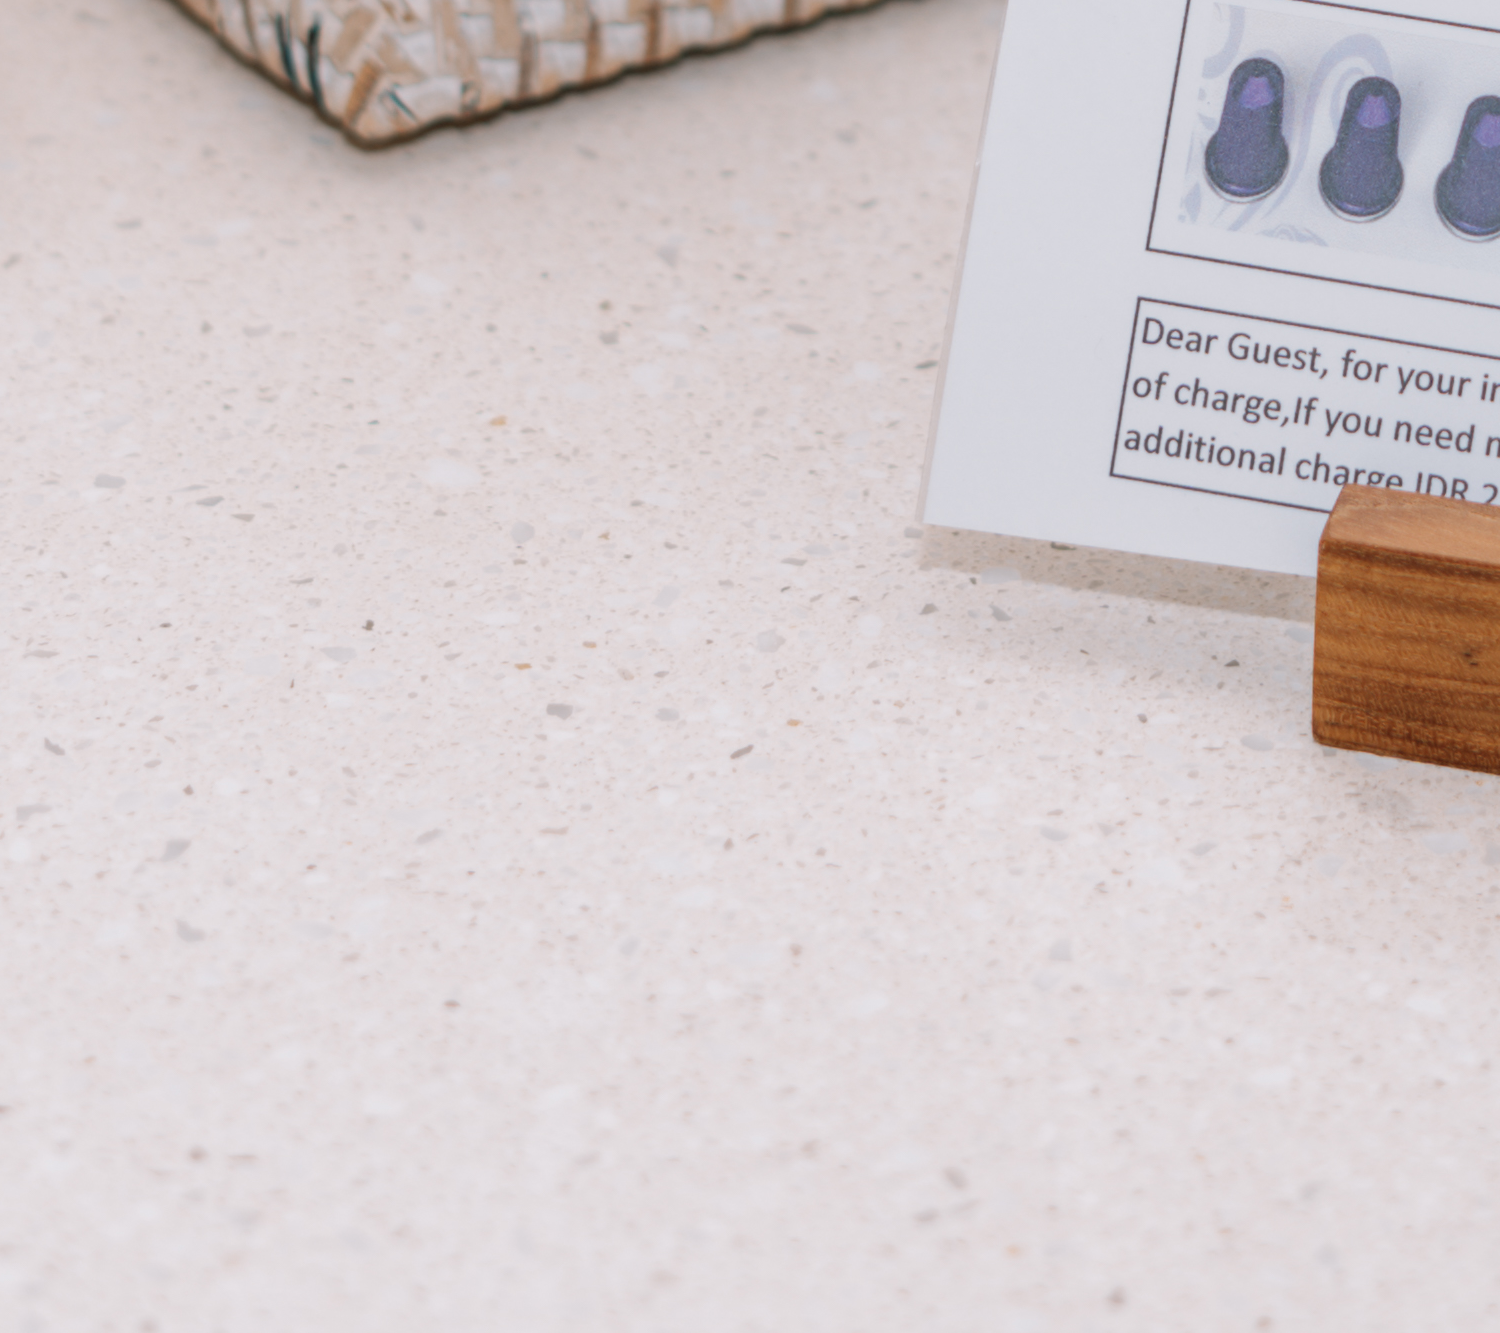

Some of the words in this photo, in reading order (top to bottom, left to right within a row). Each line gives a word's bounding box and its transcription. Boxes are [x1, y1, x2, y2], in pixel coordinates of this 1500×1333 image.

[1141, 316, 1219, 355] Dear
[1227, 331, 1329, 380] Guest,
[1340, 348, 1389, 384] for
[1397, 365, 1473, 398] your
[1131, 370, 1170, 401] of
[1324, 408, 1384, 439] you
[1393, 420, 1476, 454] need
[1123, 425, 1287, 476] additional
[1414, 471, 1470, 501] IDR
